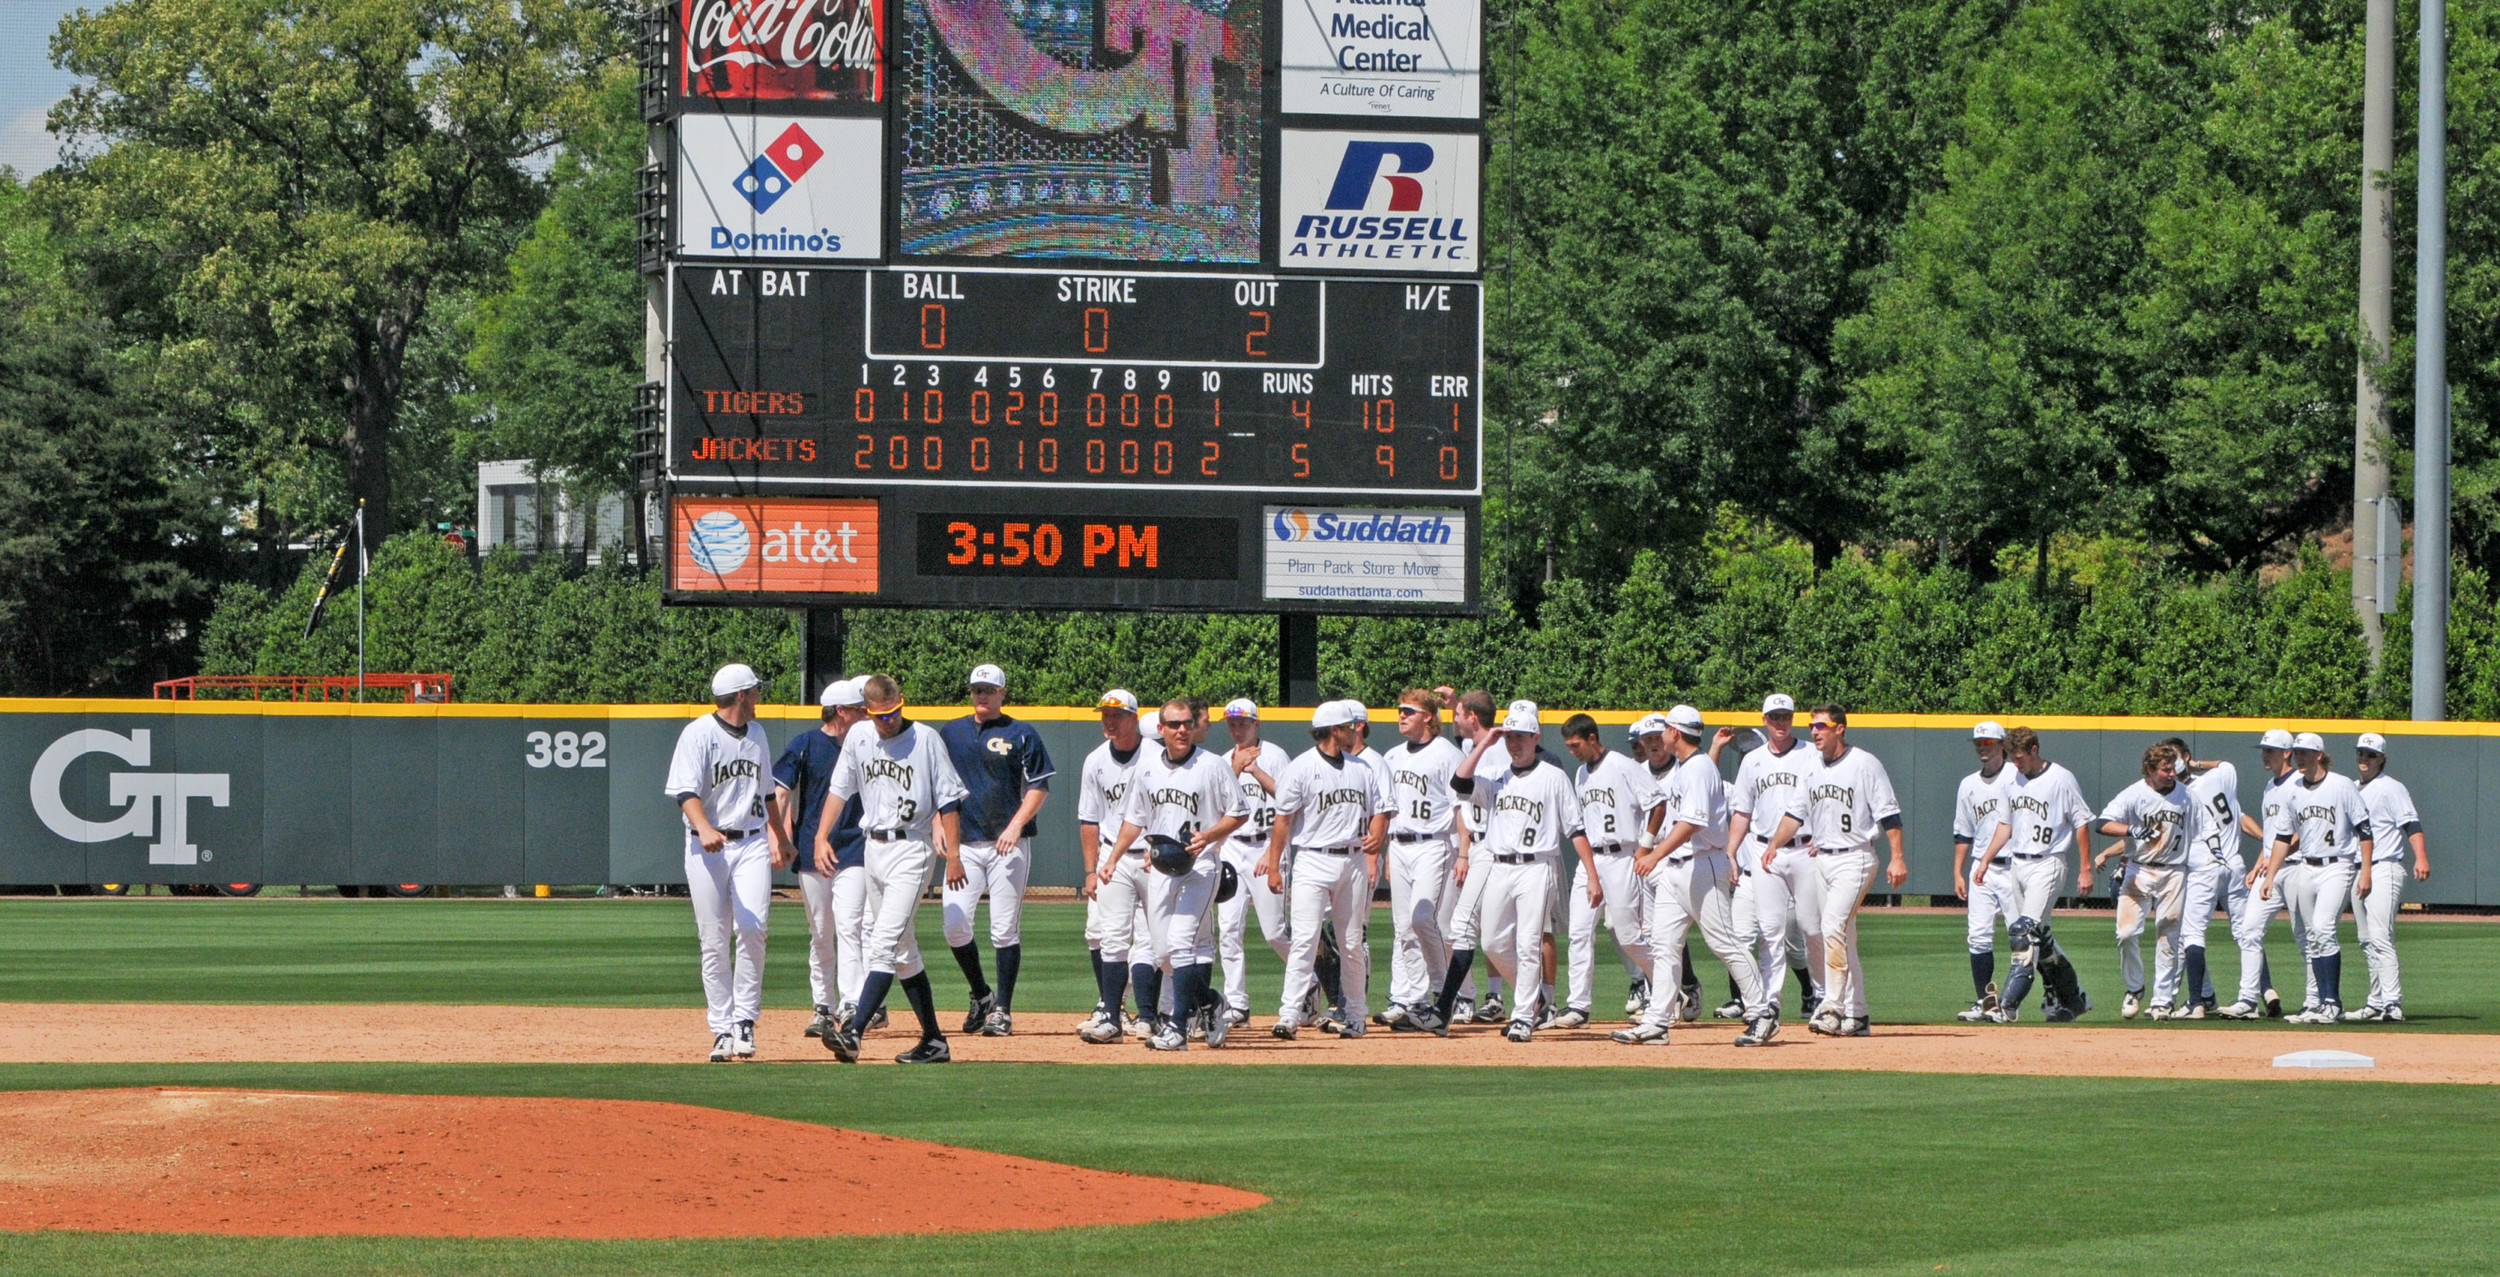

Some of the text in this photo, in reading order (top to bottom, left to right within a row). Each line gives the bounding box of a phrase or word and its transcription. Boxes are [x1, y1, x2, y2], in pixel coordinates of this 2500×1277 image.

[1331, 13, 1430, 41] Medical
[1339, 45, 1421, 72] Center
[1320, 83, 1435, 101] A Culture Of Caring
[711, 226, 842, 252] Domino's
[1294, 215, 1468, 241] RUSSELL
[1289, 243, 1462, 260] ATHLETIC
[711, 270, 809, 296] AT BAT
[904, 274, 964, 299] BALL
[1058, 277, 1136, 303] STRIKE
[1235, 281, 1279, 306] OUT
[1406, 285, 1451, 311] H/E
[921, 304, 945, 348] 0
[1084, 308, 1108, 352] 0
[1246, 311, 1270, 355] 2
[861, 364, 1468, 397] 1 2 3 4 5 6 7 8 9 10 RUNS HITS ERR
[703, 391, 803, 414] TIGERS
[1363, 399, 1394, 433] 10
[692, 438, 816, 462] JACKETS
[1314, 512, 1451, 545] Suddath
[762, 521, 858, 564] at&t
[947, 521, 1158, 568] 3:50 PM
[1288, 559, 1438, 577] Plan Pack Store Move
[1299, 585, 1423, 599] suddathatlanta.com
[526, 730, 607, 769] 382
[987, 738, 1013, 756] GT
[711, 759, 762, 789] JACKET
[1755, 772, 1798, 799] JACKET
[30, 729, 230, 864] GT
[1147, 788, 1199, 816] ACKETS
[1580, 787, 1615, 809] ACKETS
[1253, 807, 1276, 827] 42
[1411, 800, 1431, 820] 16
[1496, 796, 1544, 824] ACKETS
[1604, 814, 1615, 832] 2
[1842, 814, 1852, 833] 9
[2033, 825, 2053, 845] 38
[1523, 828, 1536, 847] 8
[2324, 830, 2335, 847] 4
